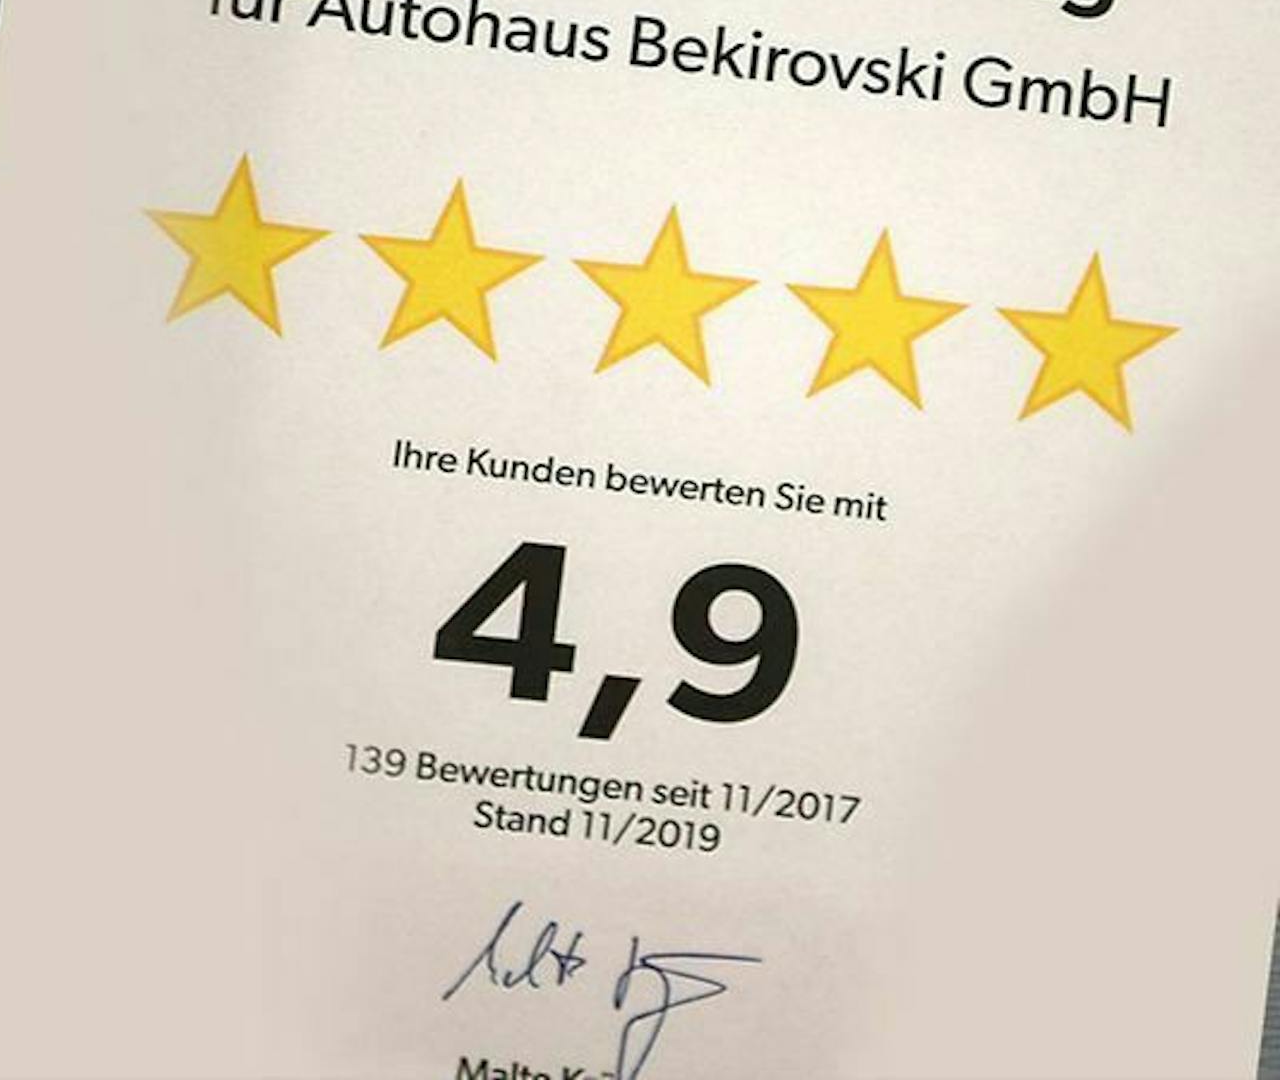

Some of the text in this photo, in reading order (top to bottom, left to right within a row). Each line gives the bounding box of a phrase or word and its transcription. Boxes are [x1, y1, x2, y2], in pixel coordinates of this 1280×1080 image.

[630, 16, 945, 100] Bekirovski
[964, 57, 1170, 127] GmbH
[394, 440, 886, 521] Ihre Kunden bewerten Sie mit
[433, 542, 798, 740] 4,9
[347, 744, 860, 823] 139 Bewertungen seit 11/2017
[474, 801, 720, 852] Stand 11/2019
